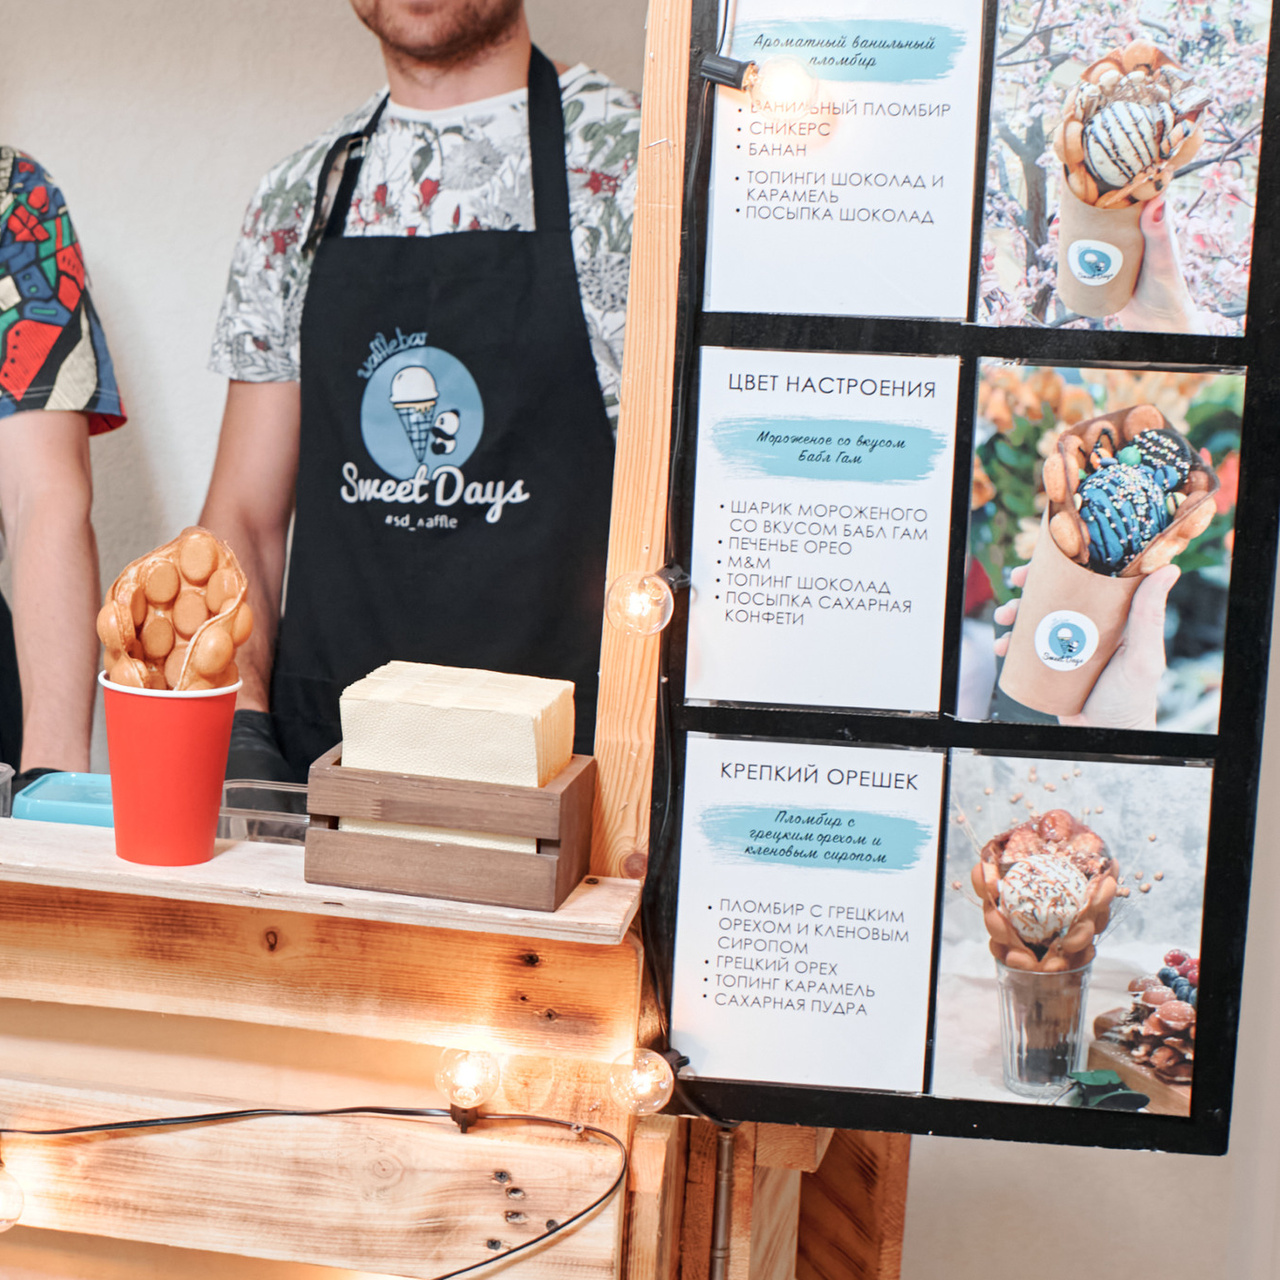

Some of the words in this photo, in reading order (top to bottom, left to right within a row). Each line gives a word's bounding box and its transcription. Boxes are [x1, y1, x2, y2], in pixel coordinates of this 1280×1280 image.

[754, 33, 847, 51] Ароматный
[852, 36, 935, 50] ванильный
[809, 53, 876, 68] пломбир
[863, 102, 951, 118] ПЛОМБИР
[749, 121, 831, 137] СНИКЕРС
[749, 142, 807, 157] БАНАН
[747, 171, 825, 186] ТОПИНГИ
[831, 172, 926, 189] ШОКОЛАД
[932, 175, 944, 188] И
[747, 189, 839, 204] КАРАМЕЛЬ
[746, 206, 833, 221] ПОСЫПКА
[840, 208, 934, 225] ШОКОЛАД
[728, 374, 778, 392] ЦВЕТ
[787, 376, 936, 398] НАСТРОЕНИЯ
[757, 431, 832, 447] Мороженое
[837, 438, 851, 446] со
[856, 433, 906, 453] вкусом
[798, 450, 831, 463] Бабл
[836, 452, 862, 464] Гам
[340, 461, 429, 504] Sweet
[432, 465, 530, 523] Days
[730, 501, 792, 516] ШАРИК
[798, 504, 928, 522] МОРОЖЕНОГО
[730, 518, 757, 532] СО
[763, 520, 837, 536] ВКУСОМ
[843, 524, 886, 538] БАБЛ
[892, 526, 928, 540] ГАМ
[728, 537, 798, 553] ПЕЧЕНЬЕ
[804, 540, 852, 555] ОРЕО
[727, 573, 792, 588] ТОПИНГ
[798, 576, 891, 595] ШОКОЛАД
[726, 591, 812, 608] ПОСЫПКА
[819, 595, 912, 613] САХАРНАЯ
[725, 609, 804, 625] КОНФЕТИ
[720, 762, 818, 784] КРЕПКИЙ
[827, 768, 919, 790] ОРЕШЕК
[774, 810, 842, 828] Пломбир
[847, 817, 856, 827] с
[749, 828, 814, 842] грецким
[817, 831, 867, 846] орехом
[872, 837, 882, 846] и
[745, 846, 818, 859] кленовым
[824, 849, 887, 864] сиропом
[720, 898, 805, 917] ПЛОМБИР
[810, 904, 823, 917] С
[829, 906, 905, 923] ГРЕЦКИМ
[718, 917, 792, 935] ОРЕХОМ
[797, 922, 809, 935] И
[815, 924, 910, 942] КЛЕНОВЫМ
[717, 936, 808, 954] СИРОПОМ
[716, 955, 789, 972] ГРЕЦКИЙ
[795, 960, 838, 975] ОРЕХ
[716, 974, 780, 990] ТОПИНГ
[785, 979, 876, 997] КАРАМЕЛЬ
[715, 992, 805, 1011] САХАРНАЯ
[811, 999, 867, 1016] ПУДРА
